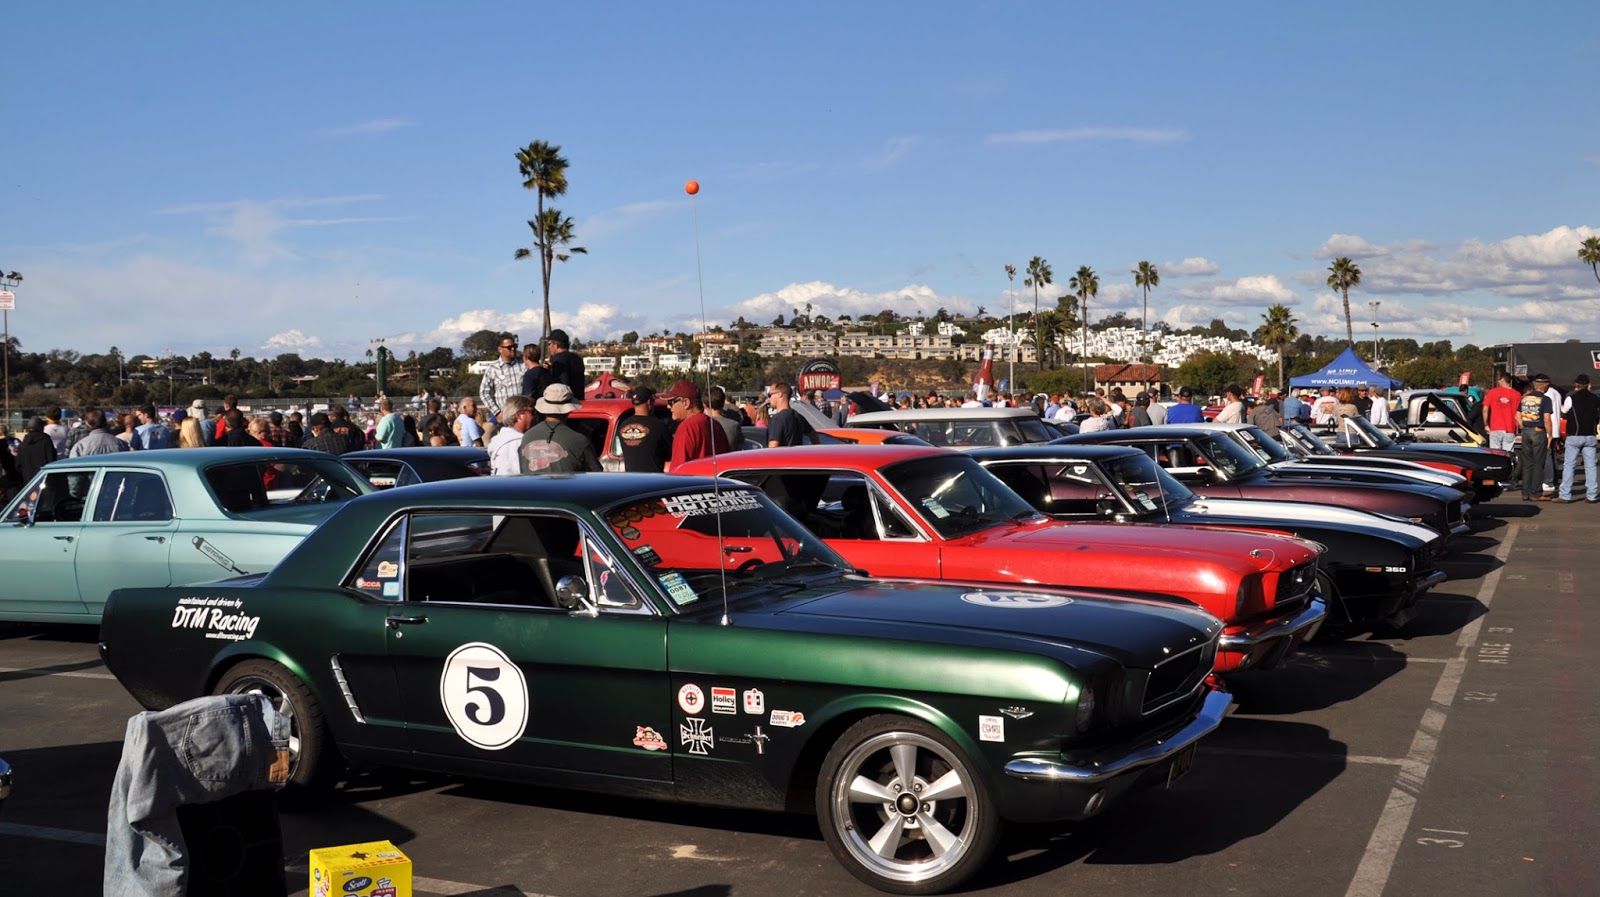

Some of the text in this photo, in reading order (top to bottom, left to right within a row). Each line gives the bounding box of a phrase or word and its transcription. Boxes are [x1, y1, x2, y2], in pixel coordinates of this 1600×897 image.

[661, 490, 757, 513] HOTCHKIS
[671, 502, 764, 518] SPORT SUSPENSION
[178, 597, 209, 606] maintained
[217, 598, 235, 607] driven
[234, 598, 243, 609] by
[172, 605, 260, 639] DTM Racing
[465, 666, 505, 726] 5
[713, 695, 735, 705] Holley
[1464, 692, 1498, 702] 32
[1416, 828, 1469, 848] 31
[347, 878, 368, 891] Scott
